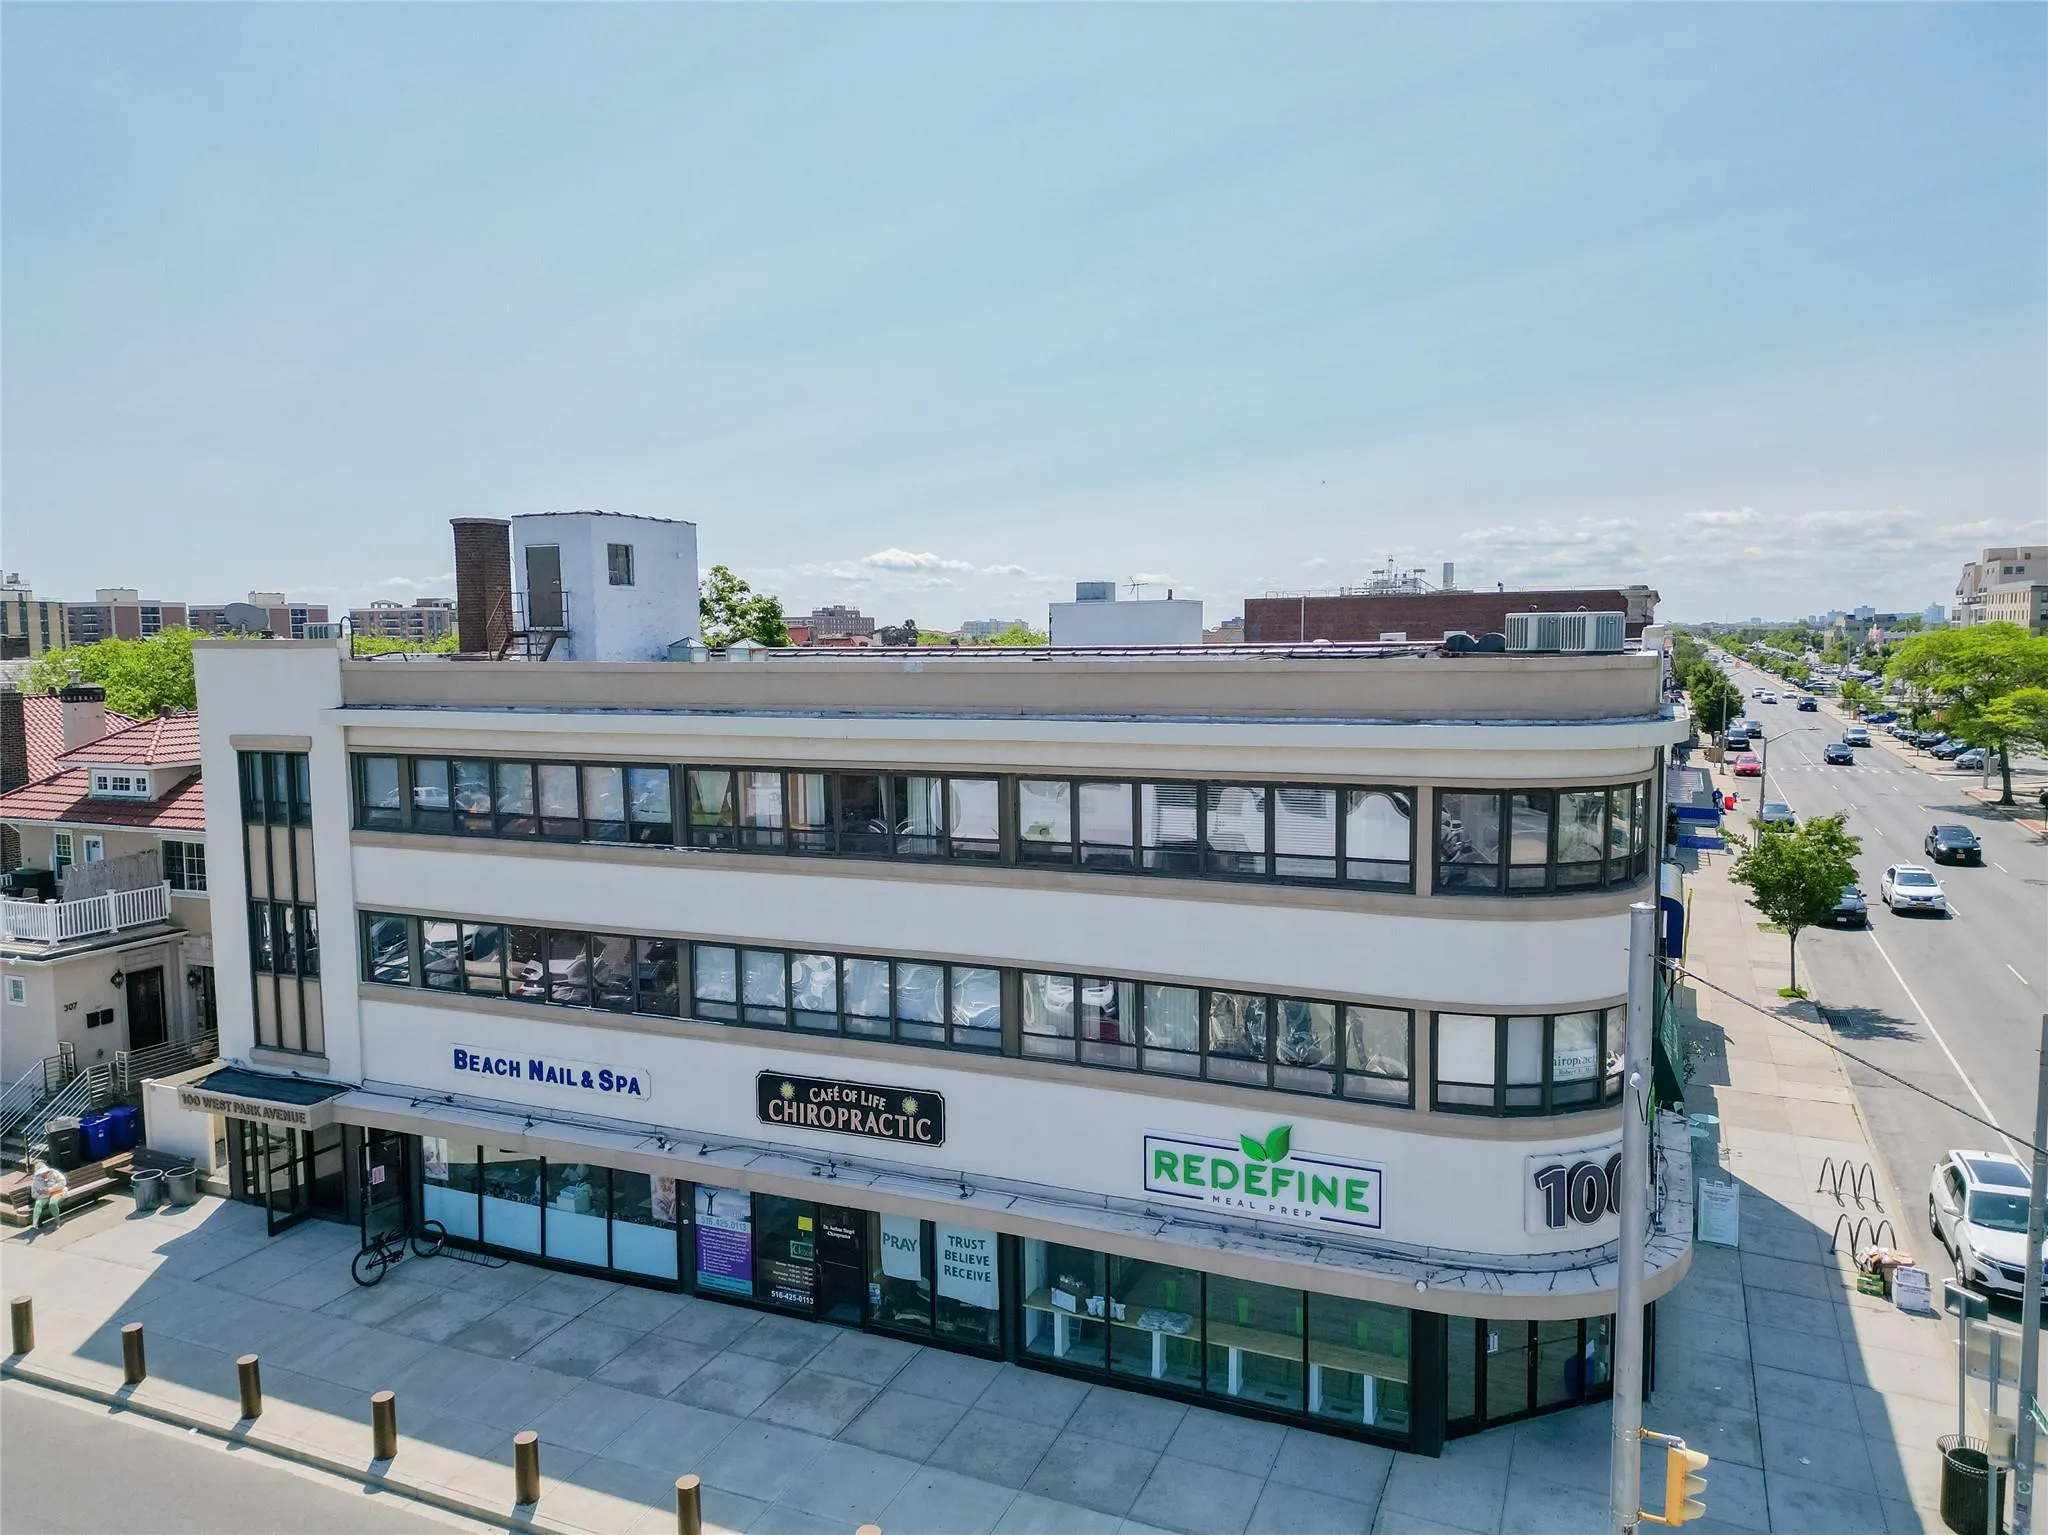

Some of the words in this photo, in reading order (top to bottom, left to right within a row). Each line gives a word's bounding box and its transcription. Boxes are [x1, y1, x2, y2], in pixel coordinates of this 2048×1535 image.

[63, 1001, 78, 1012] 307
[453, 1048, 521, 1078] BEACH
[528, 1059, 578, 1087] NAIL
[581, 1071, 594, 1089] &
[598, 1069, 642, 1096] SPA
[181, 1093, 201, 1107] 100
[202, 1096, 232, 1113] WEST
[233, 1102, 262, 1117] PARK
[262, 1108, 307, 1124] AVENUE
[809, 1085, 840, 1103] CAFÉ
[842, 1090, 858, 1104] OF
[860, 1091, 887, 1111] LIFE
[768, 1099, 932, 1142] CHIROPRACTIC
[1153, 1149, 1371, 1214] REDEFINE
[1212, 1195, 1256, 1210] MEAL
[1269, 1204, 1313, 1218] PREP
[882, 1231, 918, 1252] PRAY
[947, 1235, 986, 1250] TRUST
[944, 1249, 990, 1267] BELIEVE
[944, 1265, 992, 1283] RECEIVE
[771, 1290, 814, 1305] 516-425-0113
